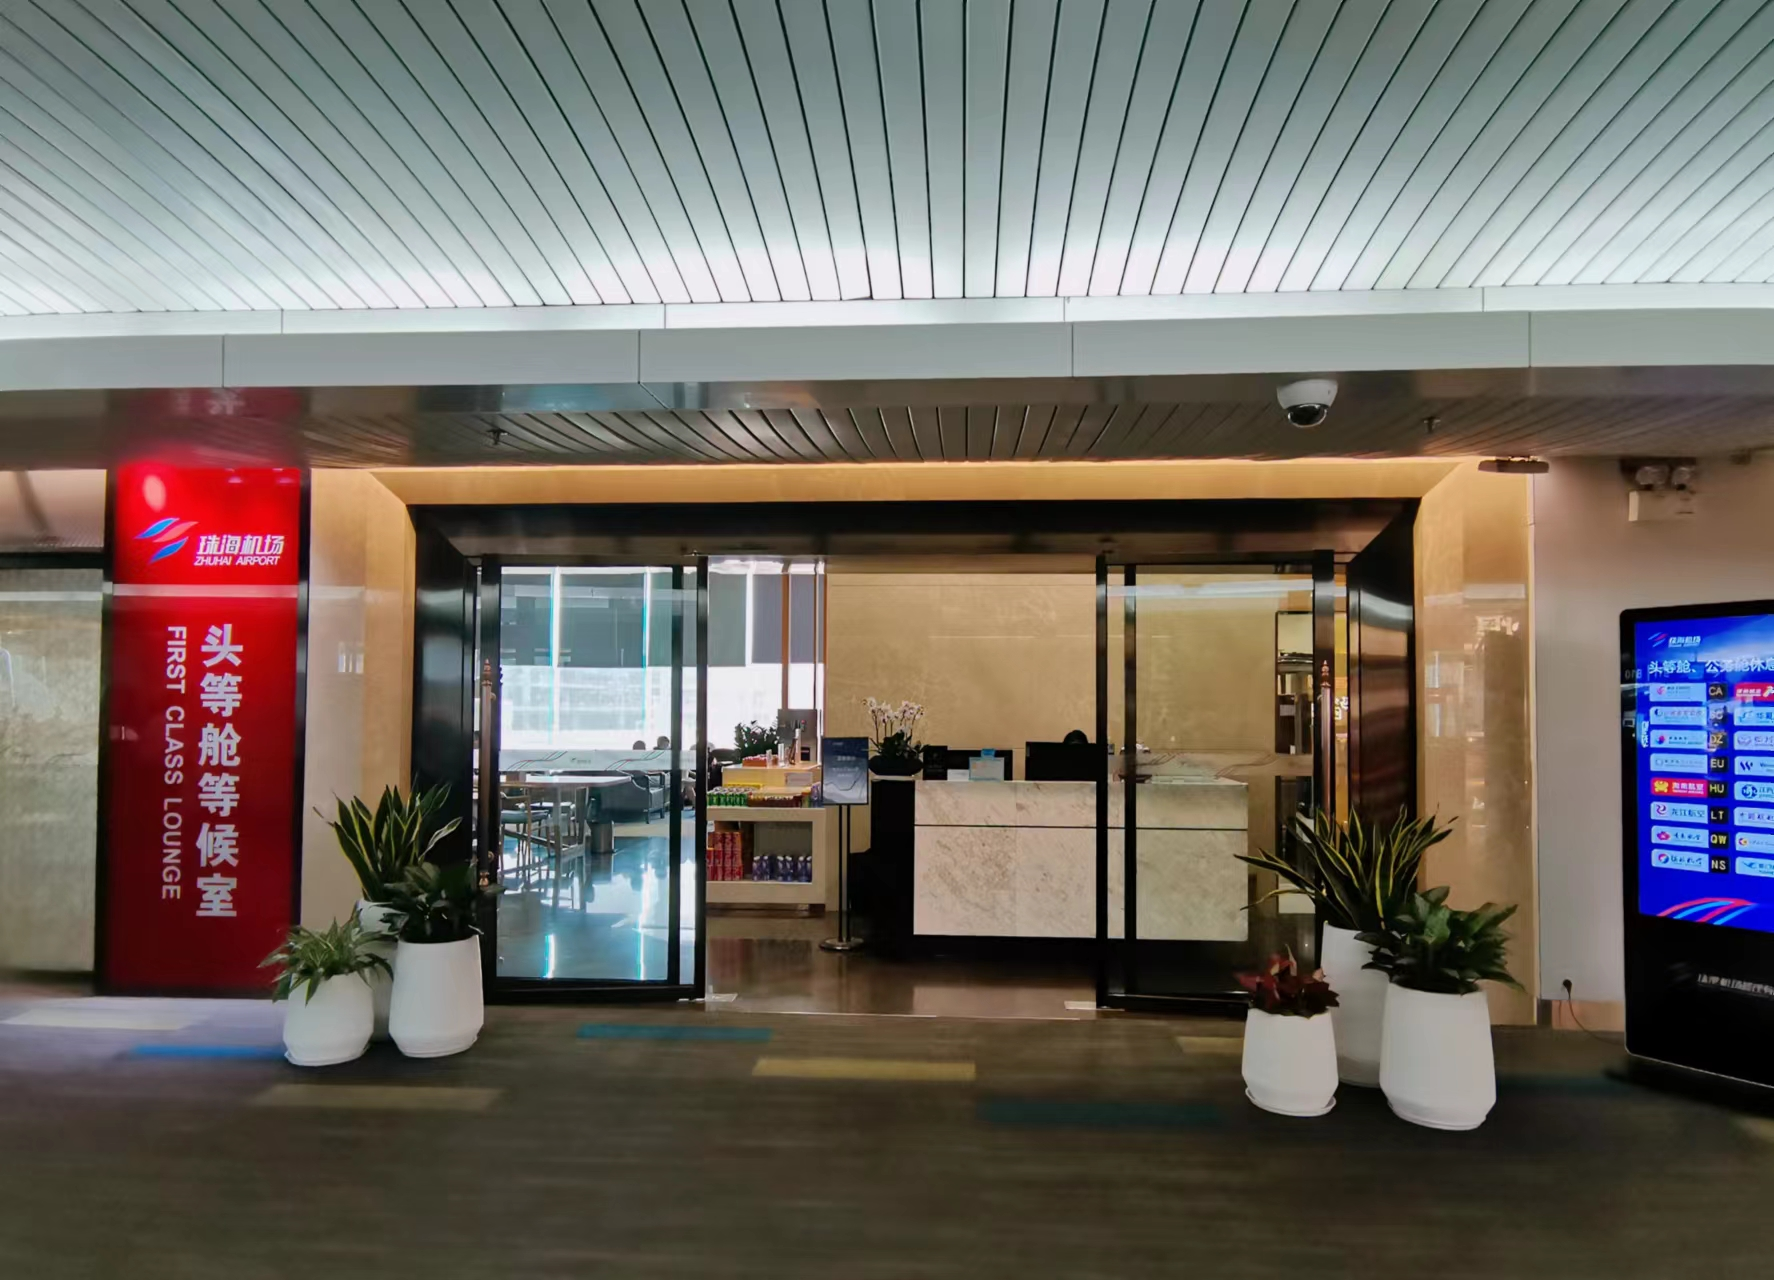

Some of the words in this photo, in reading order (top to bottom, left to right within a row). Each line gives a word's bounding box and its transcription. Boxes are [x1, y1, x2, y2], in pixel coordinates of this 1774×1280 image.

[196, 534, 285, 555] 珠海机场
[193, 556, 233, 566] ZHUHAI
[235, 555, 281, 566] AIRPORT
[166, 626, 187, 694] FIRST
[1708, 686, 1723, 696] CA
[1710, 734, 1723, 744] DZ
[164, 705, 185, 785] CLASS
[1710, 758, 1724, 768] EU
[196, 624, 243, 917] 头等舱等候室
[1709, 784, 1724, 793] HU
[1711, 811, 1724, 820] LT
[1711, 834, 1727, 844] QW
[162, 798, 182, 900] LOUNGE
[1711, 860, 1726, 870] NS
